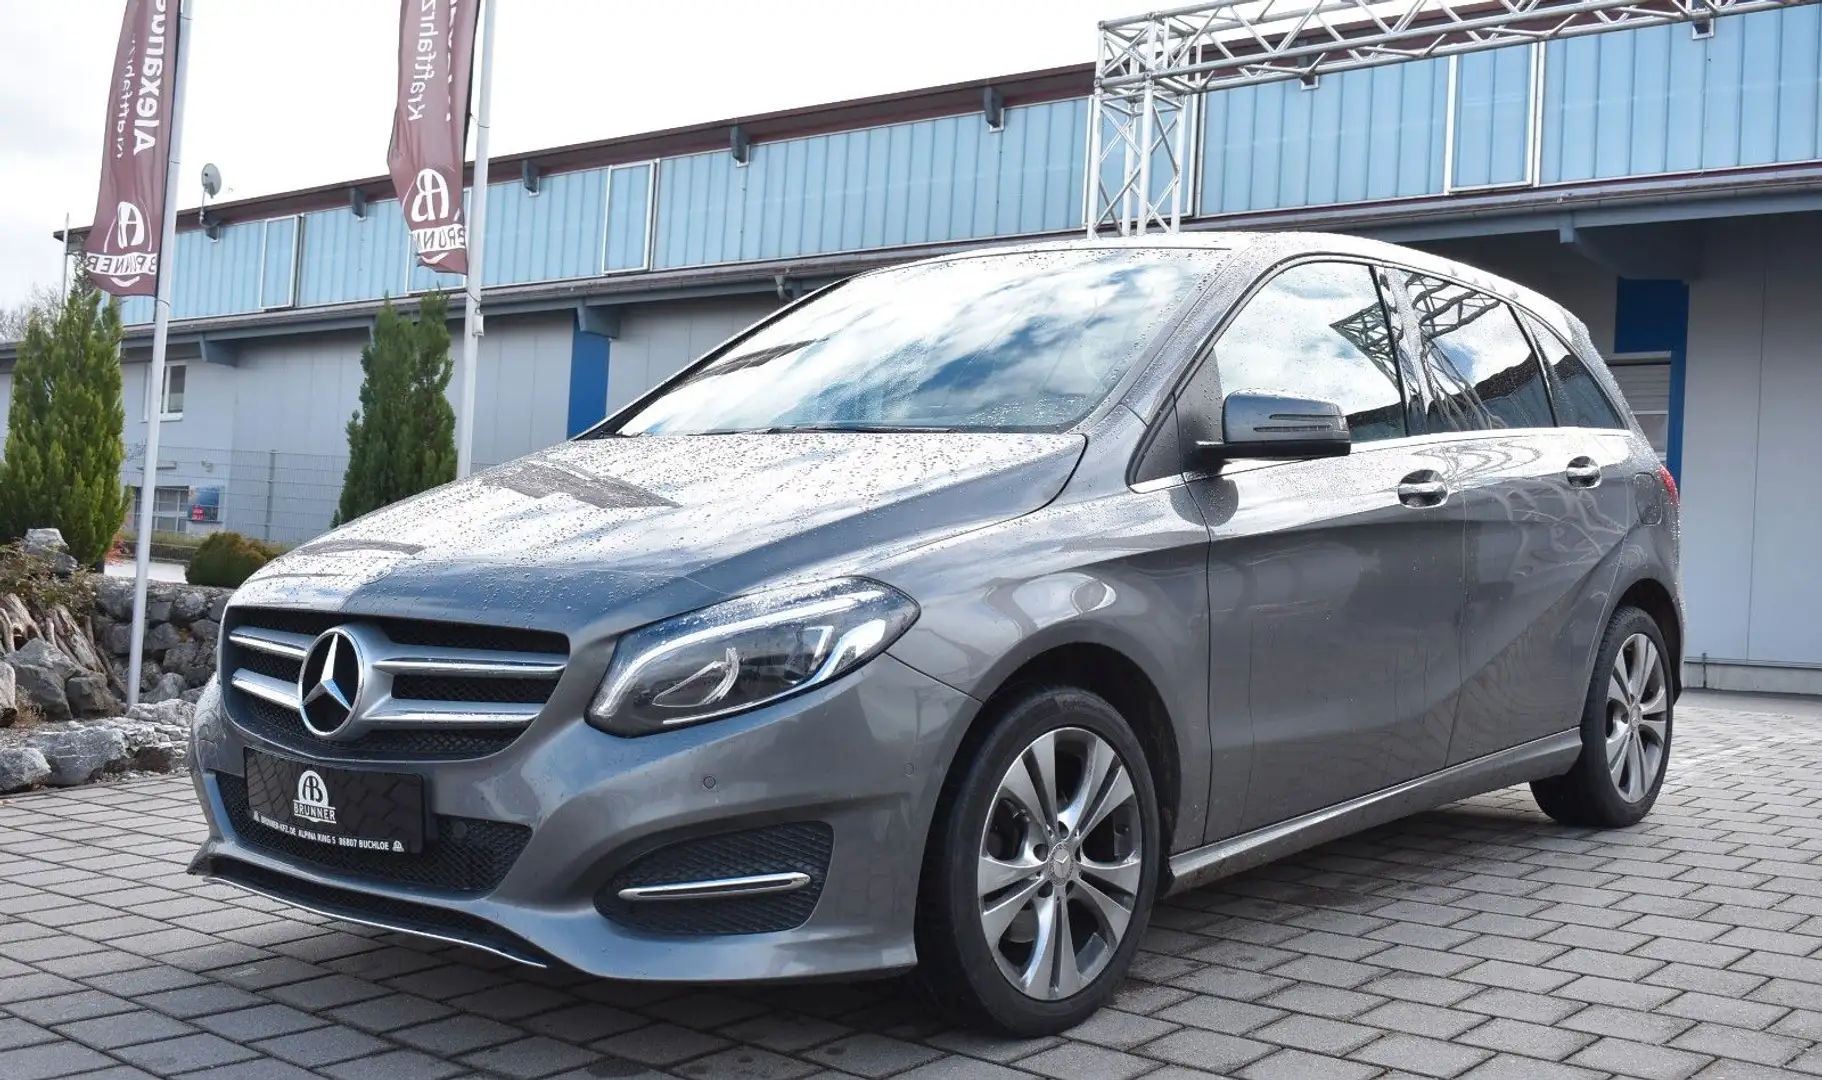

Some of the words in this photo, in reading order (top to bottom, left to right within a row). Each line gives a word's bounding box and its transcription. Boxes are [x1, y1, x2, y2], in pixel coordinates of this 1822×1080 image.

[293, 802, 336, 821] BRUNNER
[298, 829, 317, 841] ALPINA
[317, 833, 332, 844] RING
[359, 839, 389, 850] BUCHLOE
